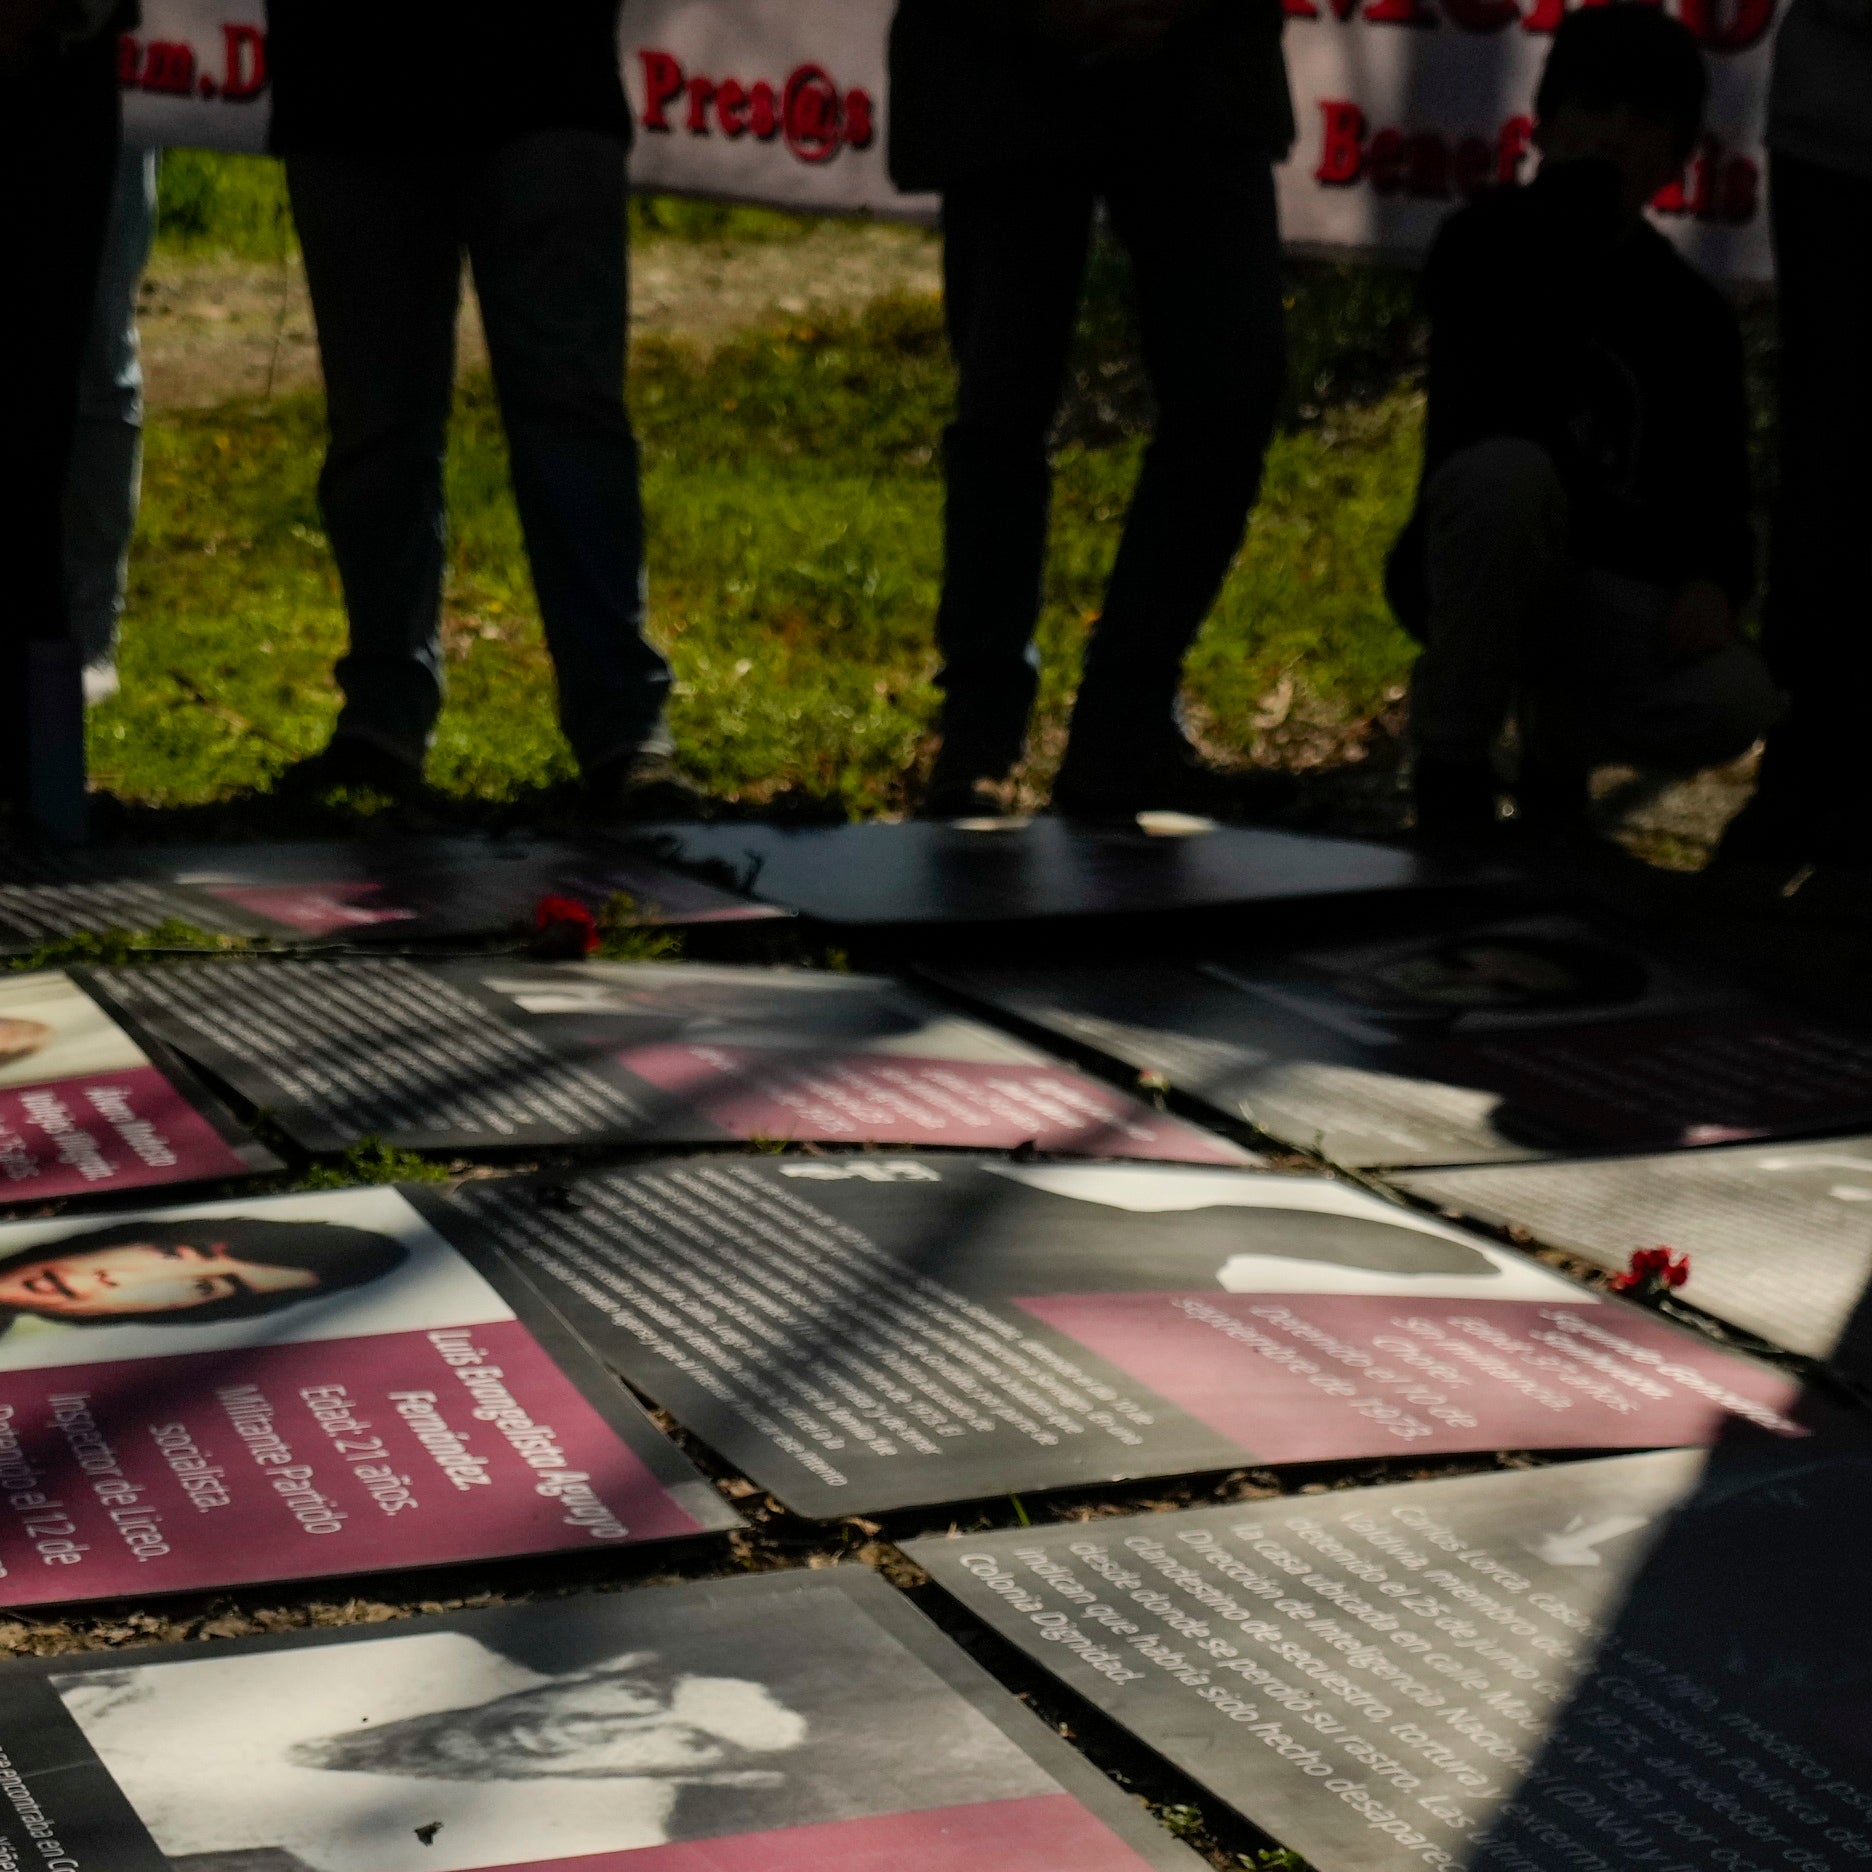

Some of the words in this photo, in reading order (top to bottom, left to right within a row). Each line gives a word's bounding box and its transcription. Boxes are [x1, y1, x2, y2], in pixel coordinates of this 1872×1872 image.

[428, 1331, 488, 1365] Luis
[46, 1391, 123, 1476] Inspector
[300, 1384, 371, 1437] Edad:
[455, 1367, 567, 1468] Evangelista
[149, 1423, 230, 1513] socialista.
[216, 1384, 292, 1465] Militante
[266, 1465, 348, 1534] Partido
[335, 1436, 389, 1461] 21
[389, 1392, 491, 1491] Fernández.
[9, 1493, 64, 1511] el
[94, 1480, 146, 1506] de
[354, 1465, 418, 1516] años.
[536, 1471, 651, 1538] Aguayo
[23, 1512, 76, 1538] 12
[109, 1506, 170, 1562] Liceo.
[36, 1540, 90, 1565] de
